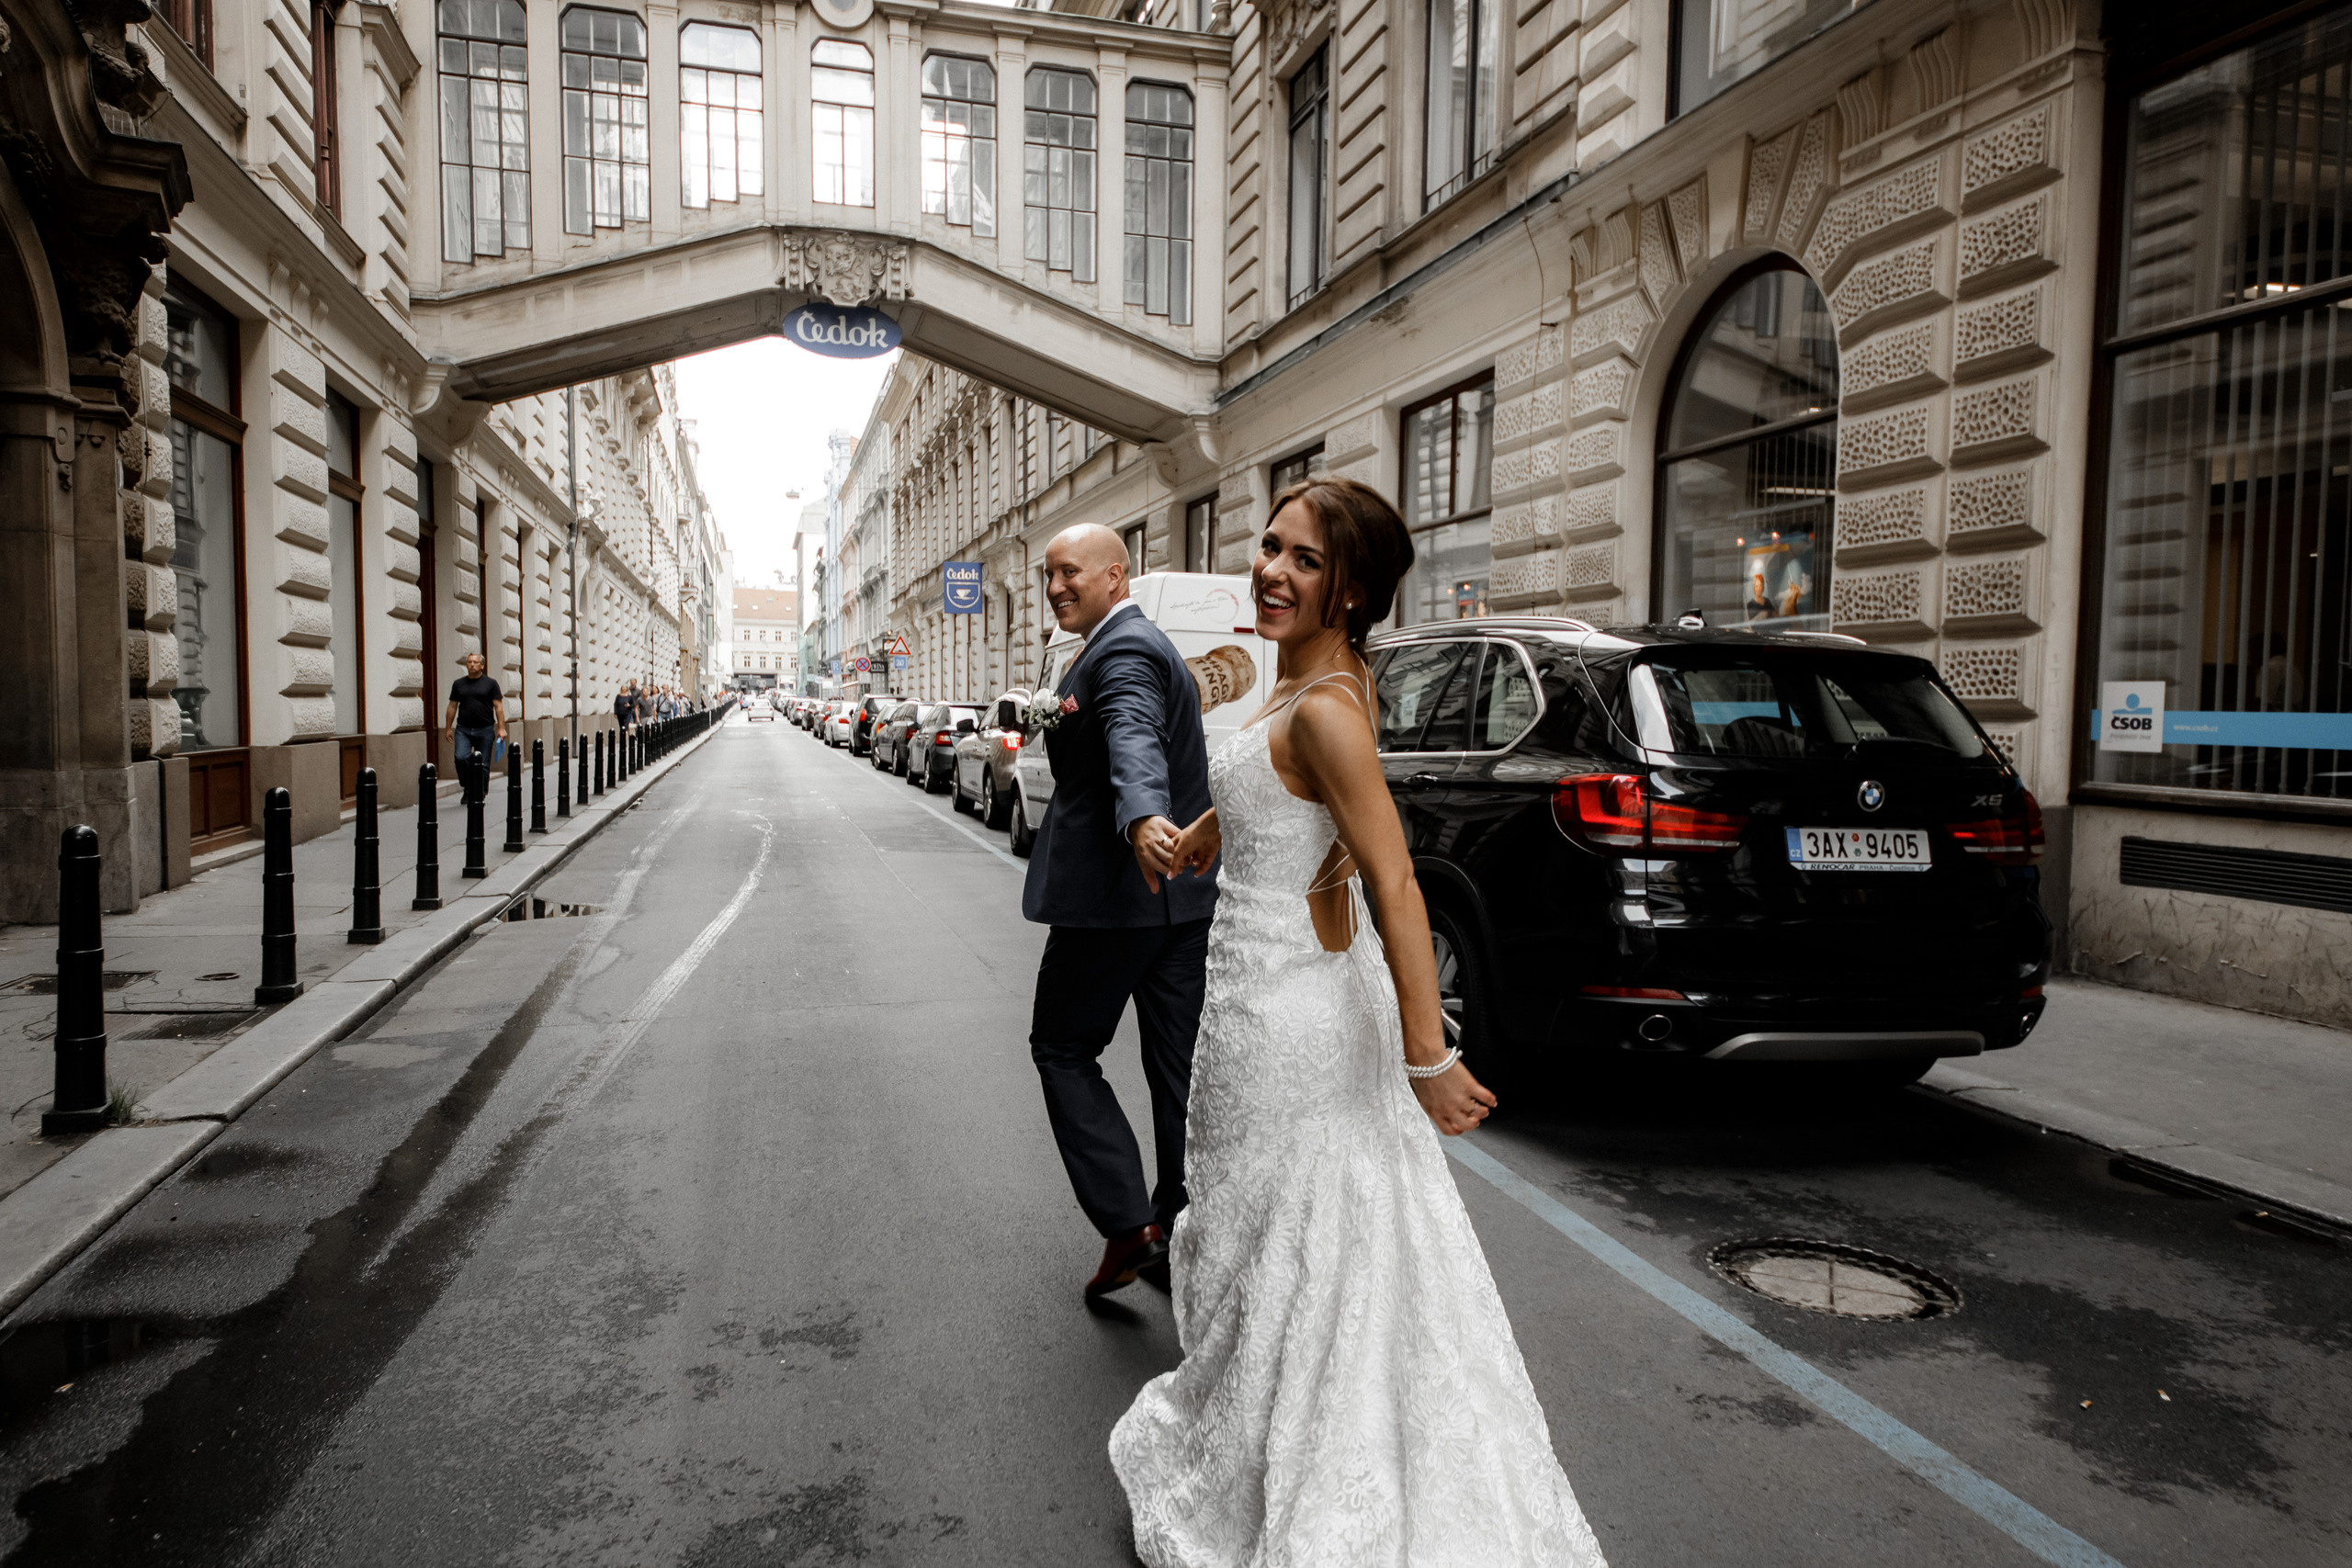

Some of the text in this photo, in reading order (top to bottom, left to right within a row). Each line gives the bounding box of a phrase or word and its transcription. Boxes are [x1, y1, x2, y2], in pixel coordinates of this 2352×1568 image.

[797, 310, 888, 347] Čedok
[946, 568, 979, 580] Čedok
[2110, 716, 2153, 730] ČSOB
[1970, 795, 2003, 807] X5
[1806, 832, 1918, 859] 3AX 9405
